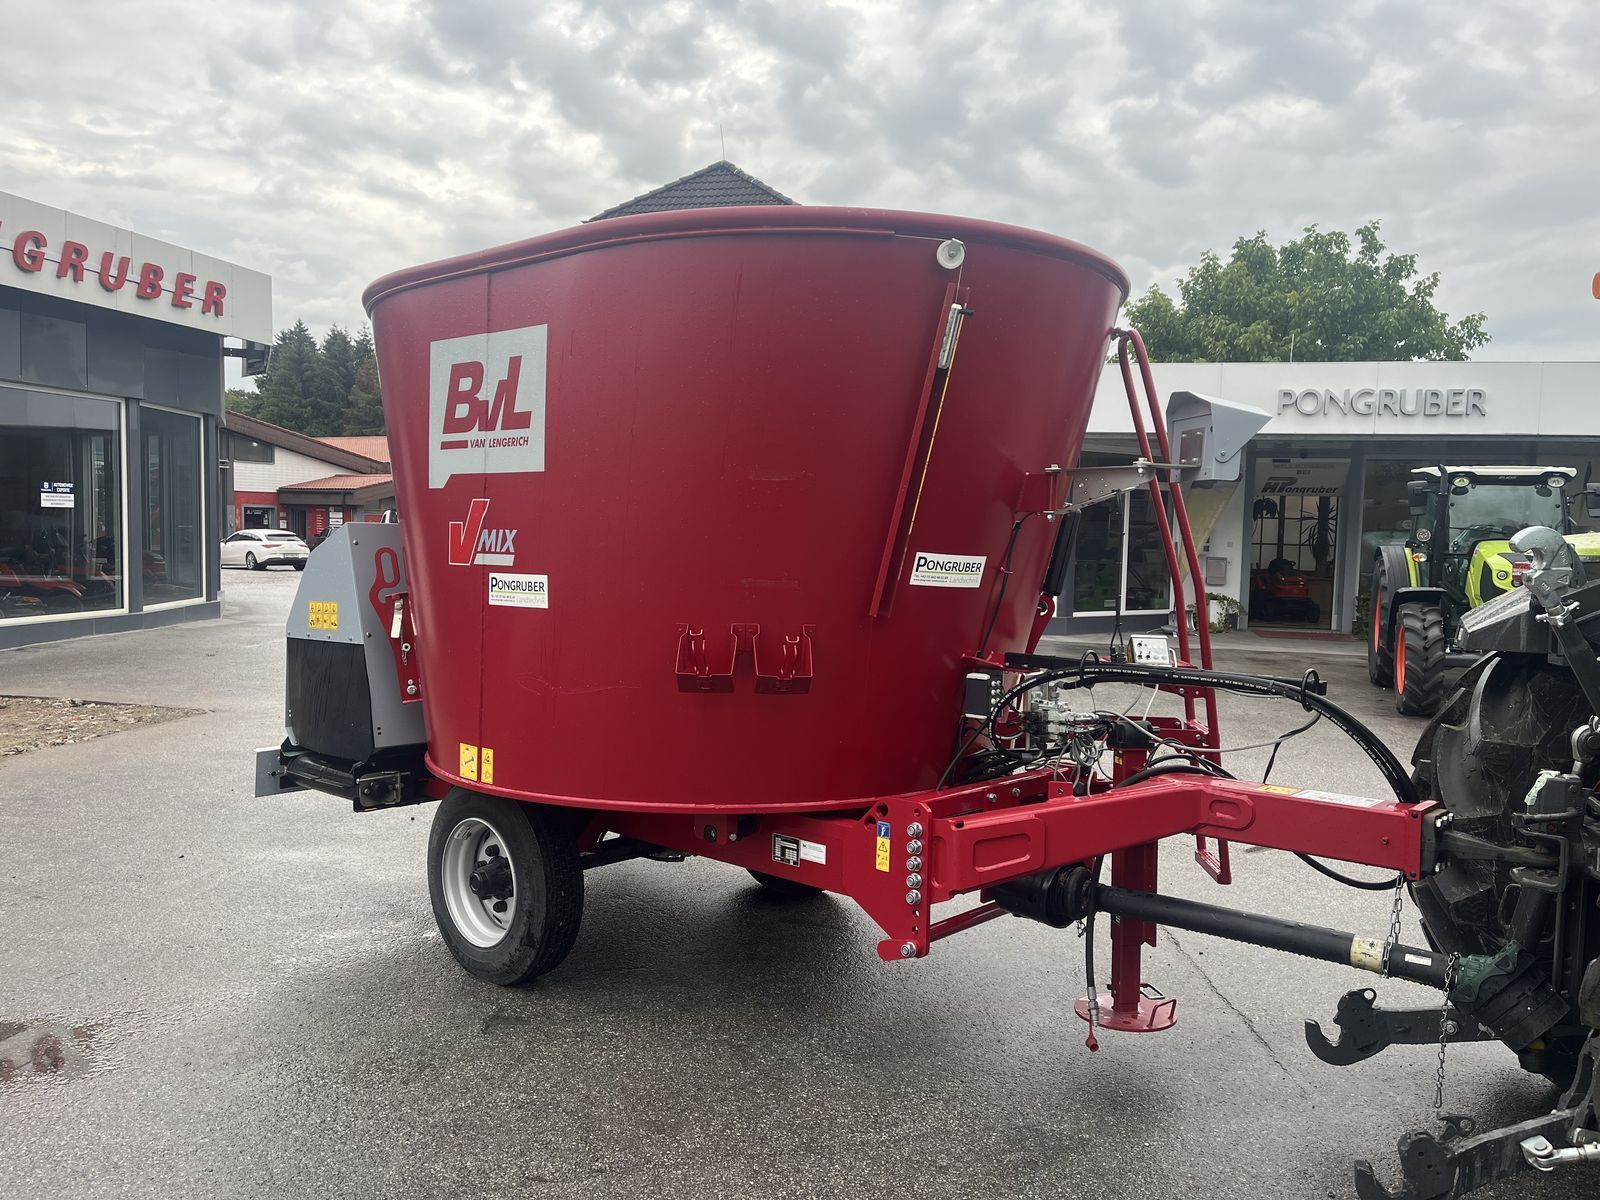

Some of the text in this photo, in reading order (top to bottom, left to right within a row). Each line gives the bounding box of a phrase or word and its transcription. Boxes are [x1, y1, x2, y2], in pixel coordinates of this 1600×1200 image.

[0, 220, 226, 317] GRUBER
[1276, 387, 1487, 417] PONGRUBER
[470, 436, 529, 449] VAN LENGERICH
